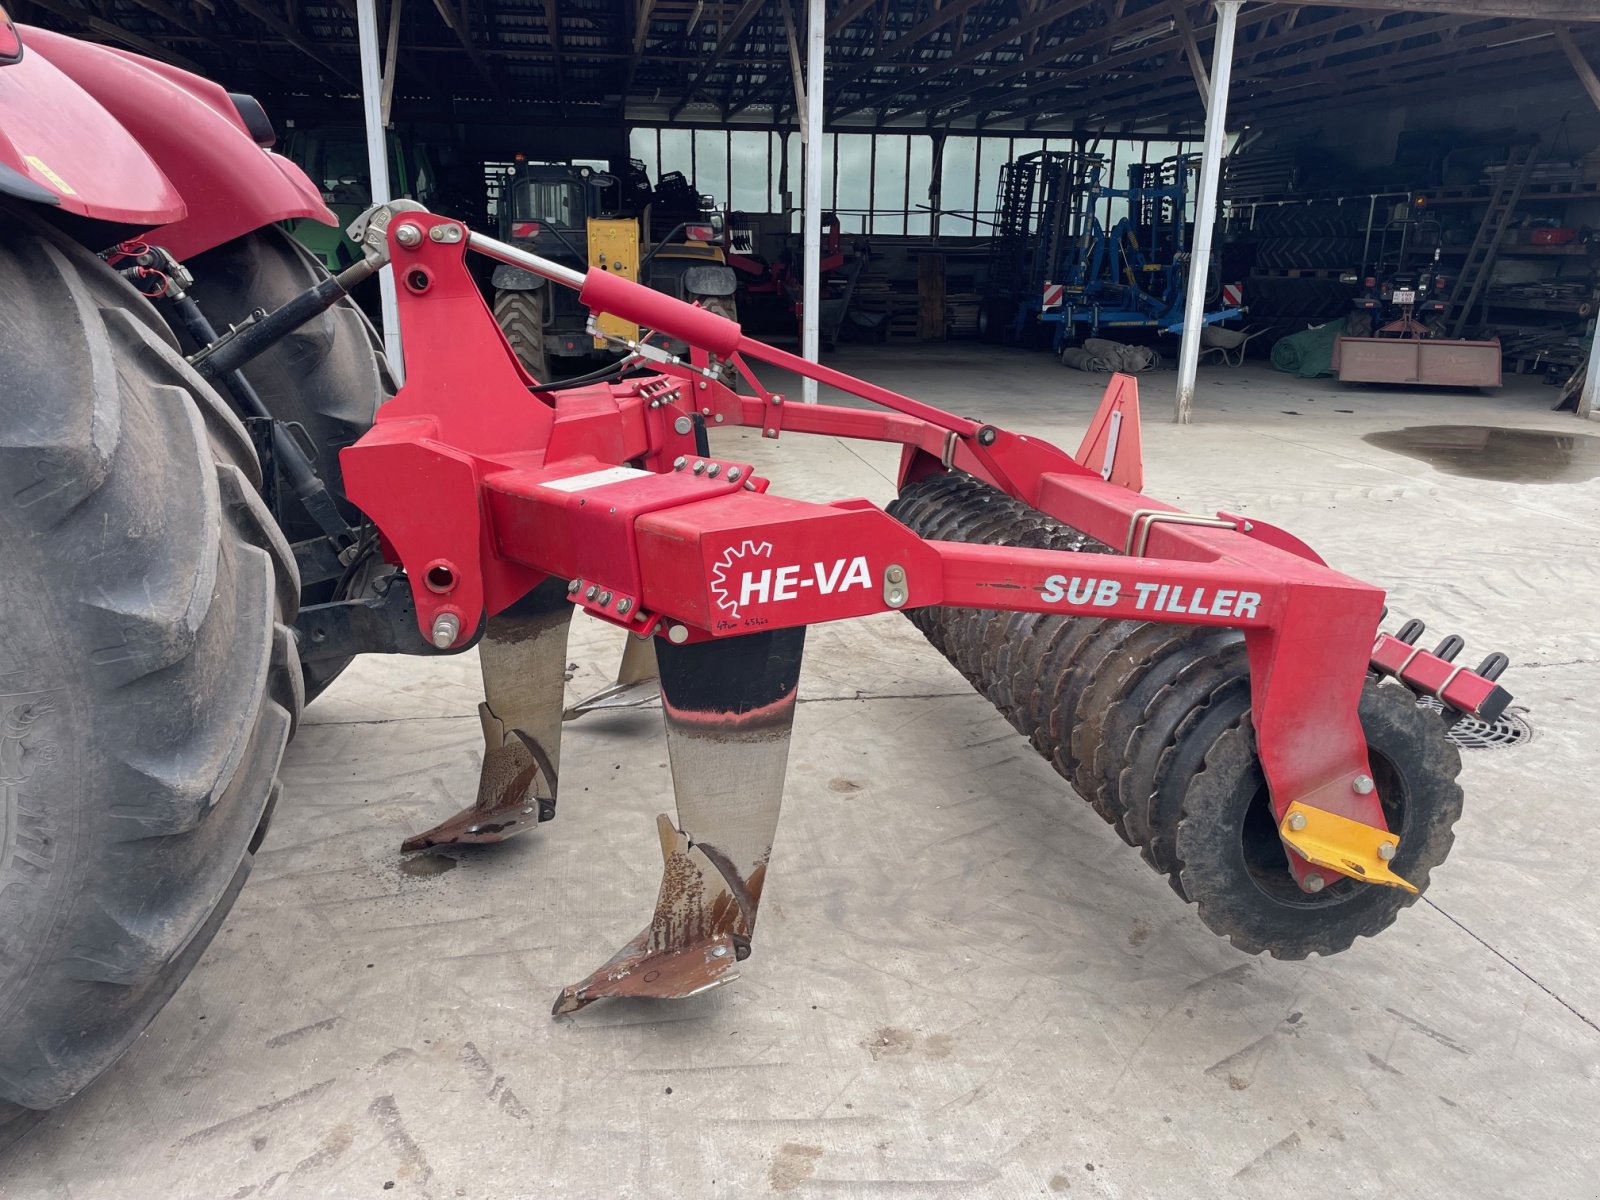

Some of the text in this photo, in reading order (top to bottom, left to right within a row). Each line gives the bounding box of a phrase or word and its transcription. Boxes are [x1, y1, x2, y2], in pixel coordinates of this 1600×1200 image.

[740, 557, 872, 606] HE-VA
[1041, 575, 1261, 618] SUB TILLER
